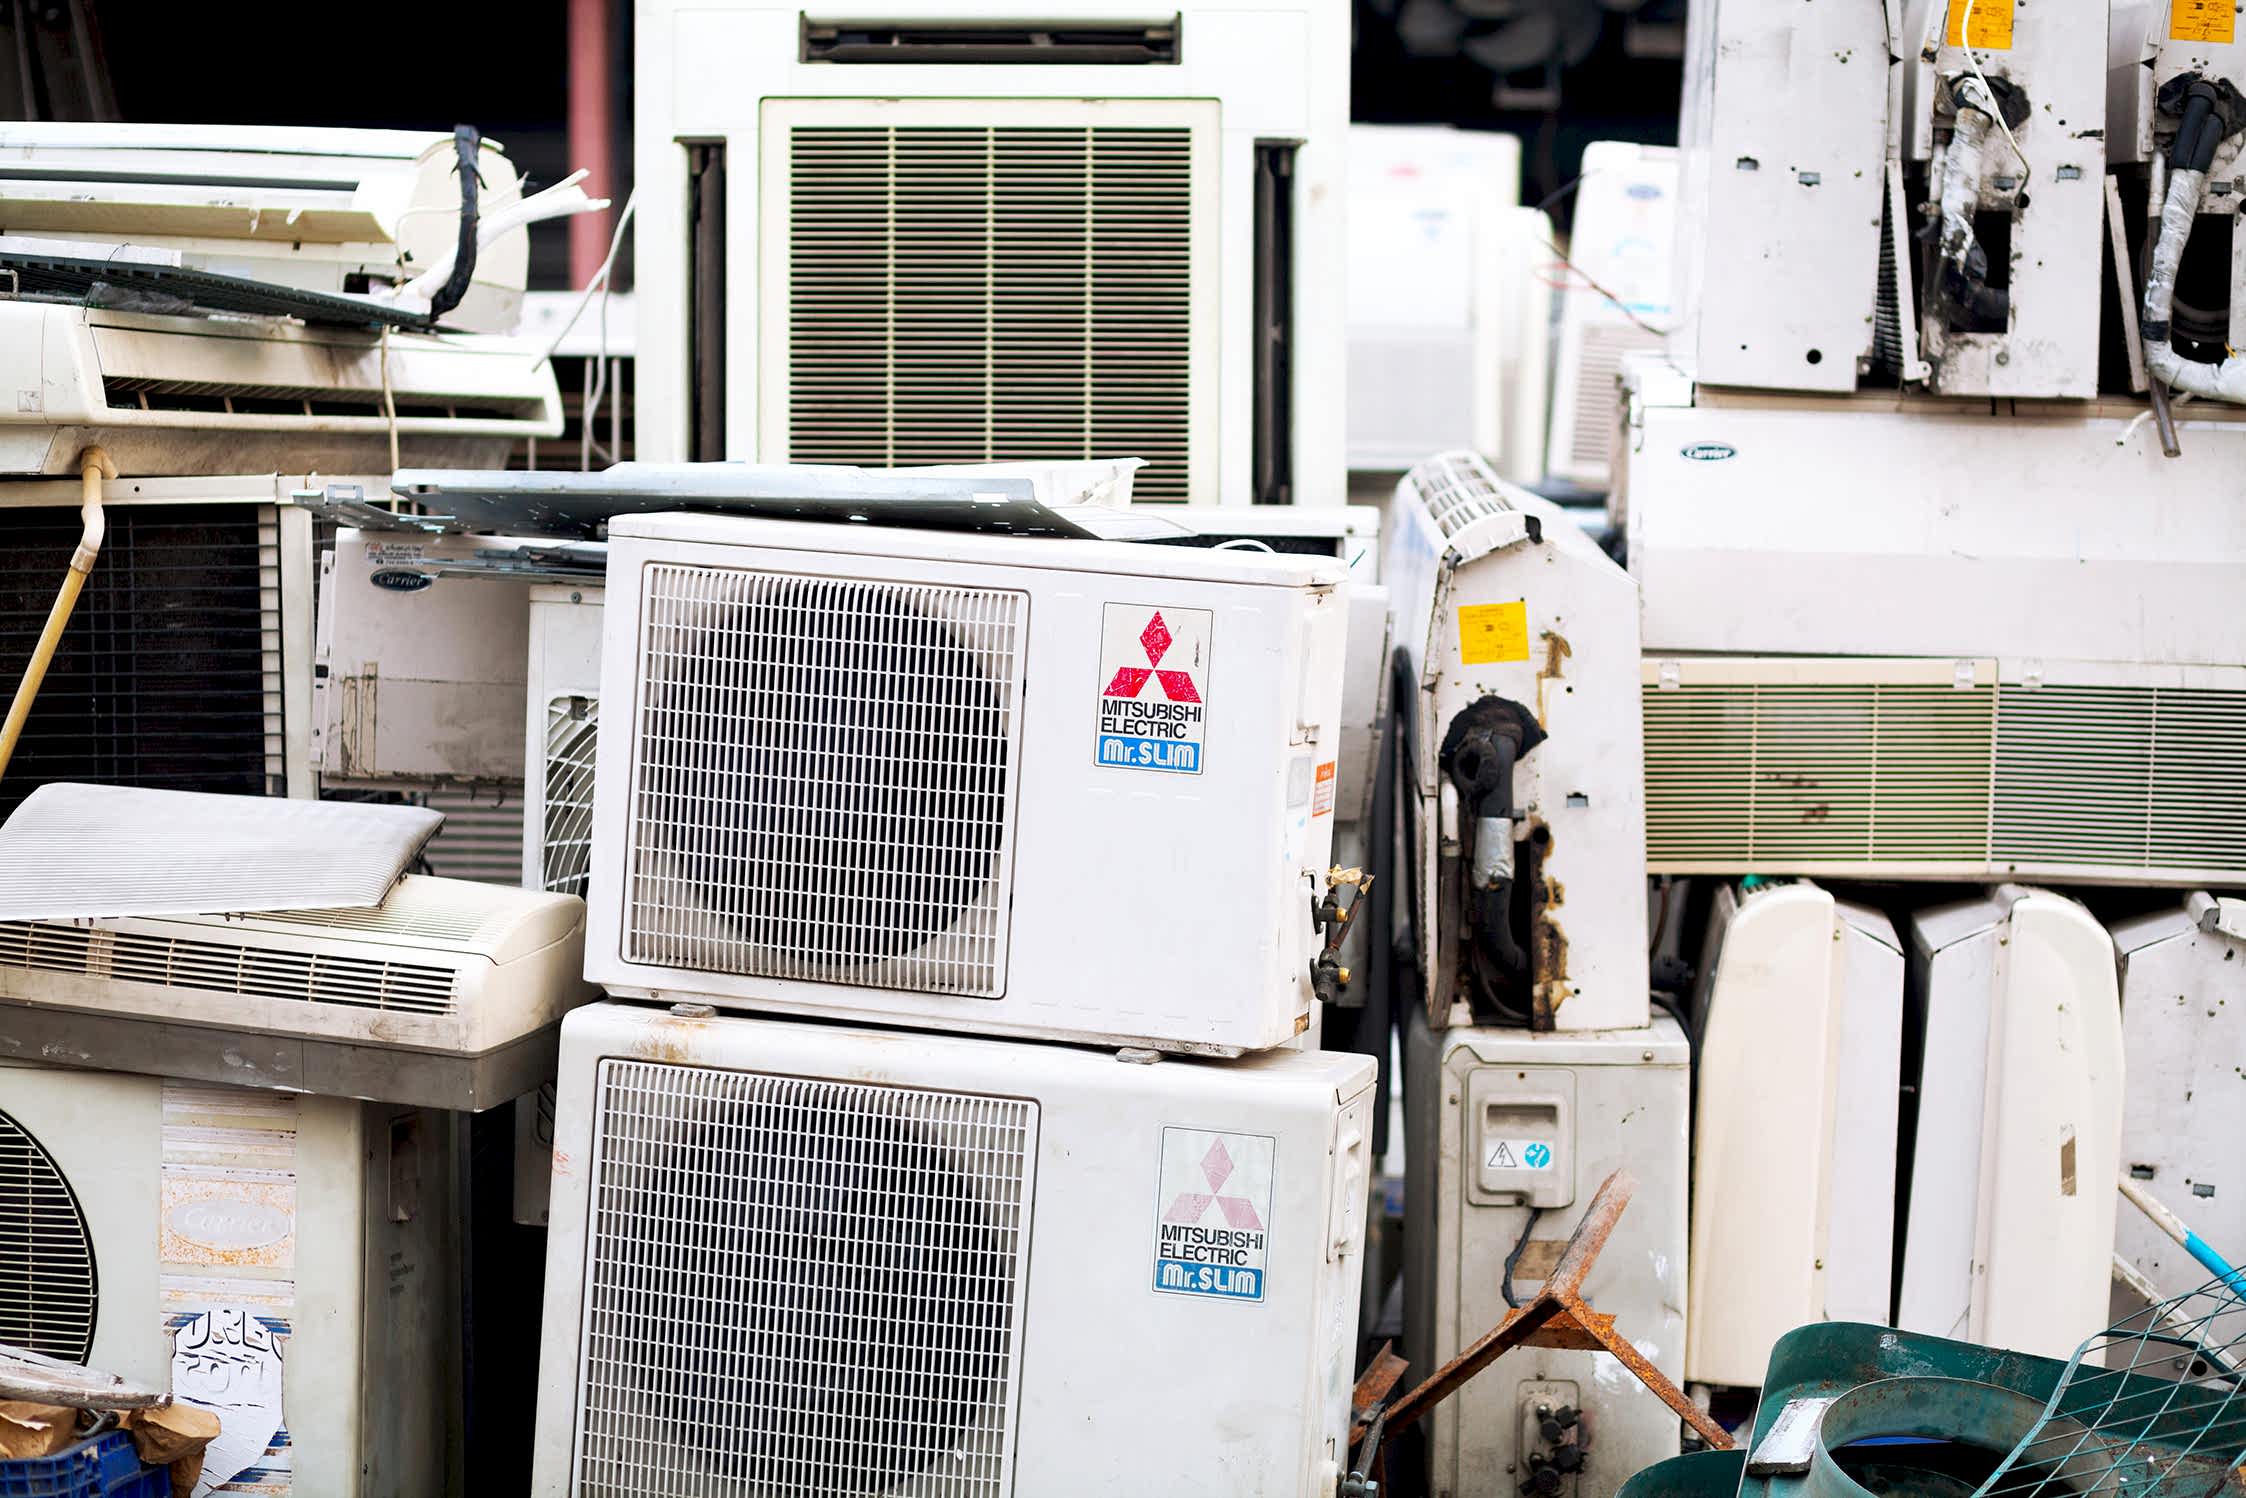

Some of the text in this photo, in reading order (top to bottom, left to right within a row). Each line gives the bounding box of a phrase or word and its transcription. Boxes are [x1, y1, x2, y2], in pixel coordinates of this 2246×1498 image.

[1102, 699, 1201, 722] MITSUBISHI
[1101, 717, 1186, 739] ELECTRIC
[1103, 738, 1194, 768] Mr.SLIM
[1161, 1224, 1263, 1250] MITSUBISHI
[1160, 1242, 1248, 1266] ELECTRIC
[1162, 1263, 1256, 1295] Mr.SLIM
